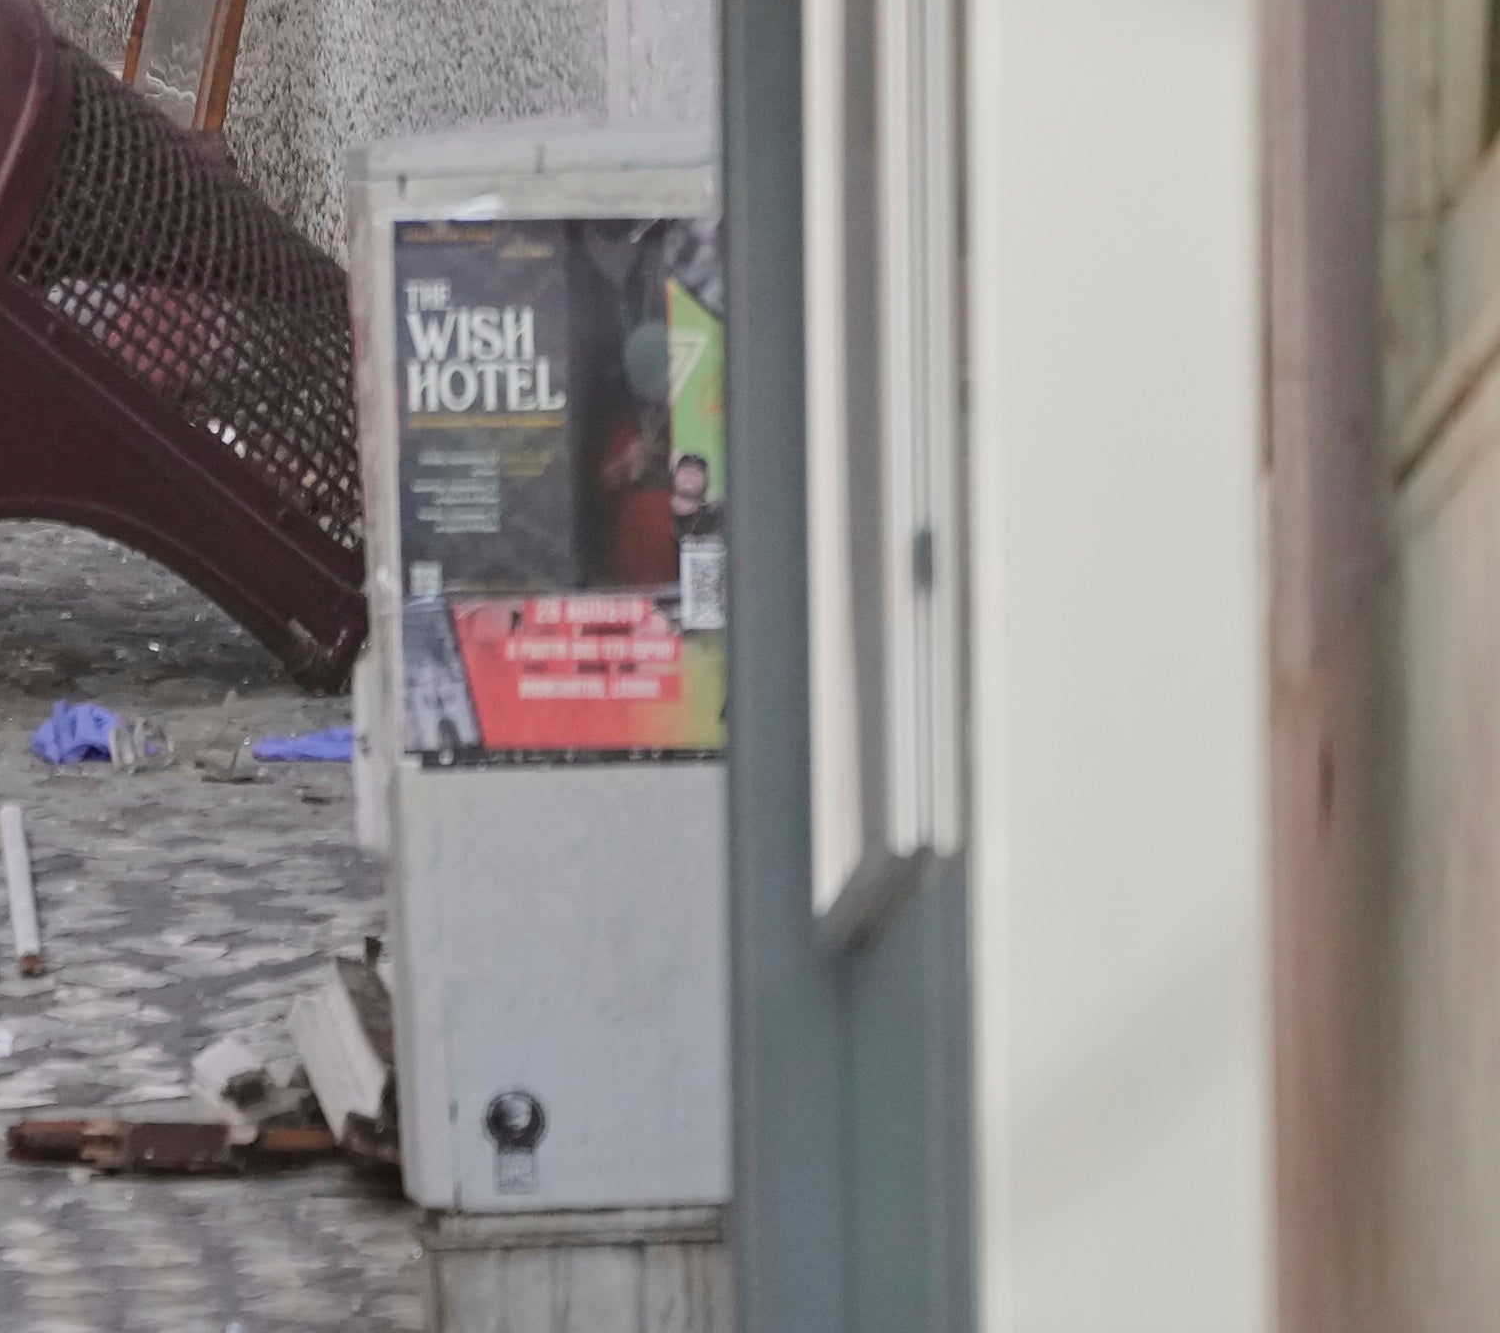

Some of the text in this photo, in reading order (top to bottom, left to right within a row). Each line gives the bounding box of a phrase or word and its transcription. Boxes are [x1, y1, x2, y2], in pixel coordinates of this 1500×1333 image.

[405, 279, 450, 311] THE
[405, 304, 535, 362] WISH
[406, 355, 568, 413] HOTEL
